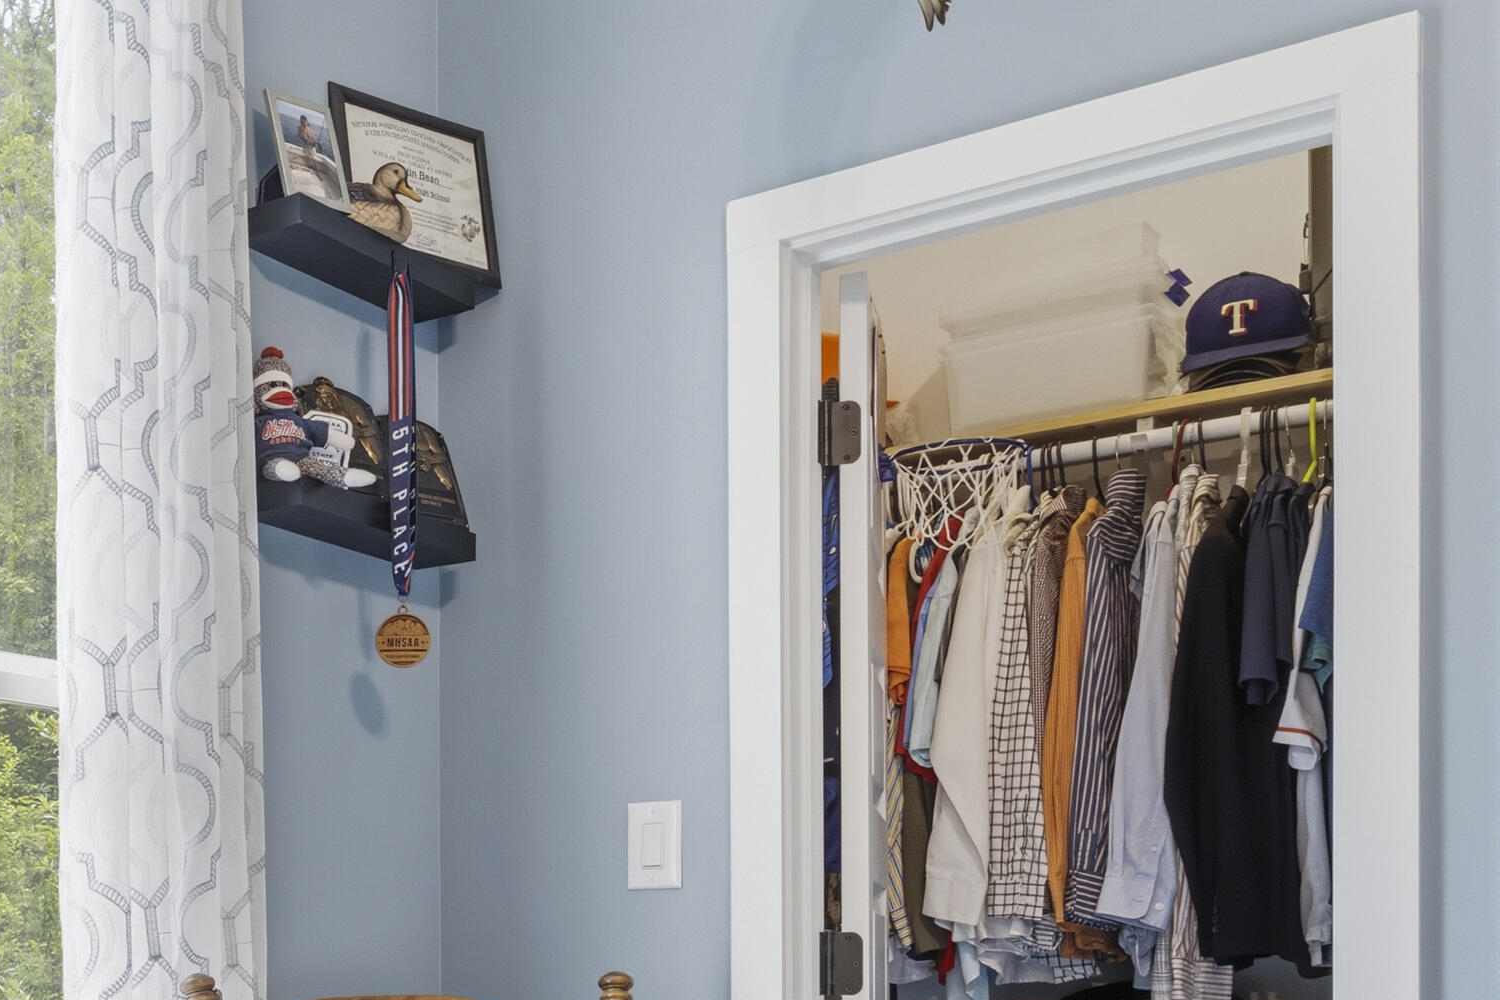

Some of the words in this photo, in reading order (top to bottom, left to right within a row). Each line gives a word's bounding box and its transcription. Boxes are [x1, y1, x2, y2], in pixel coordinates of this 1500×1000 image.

[1220, 299, 1258, 336] T
[392, 425, 409, 478] 5TH
[392, 488, 409, 576] PLACE
